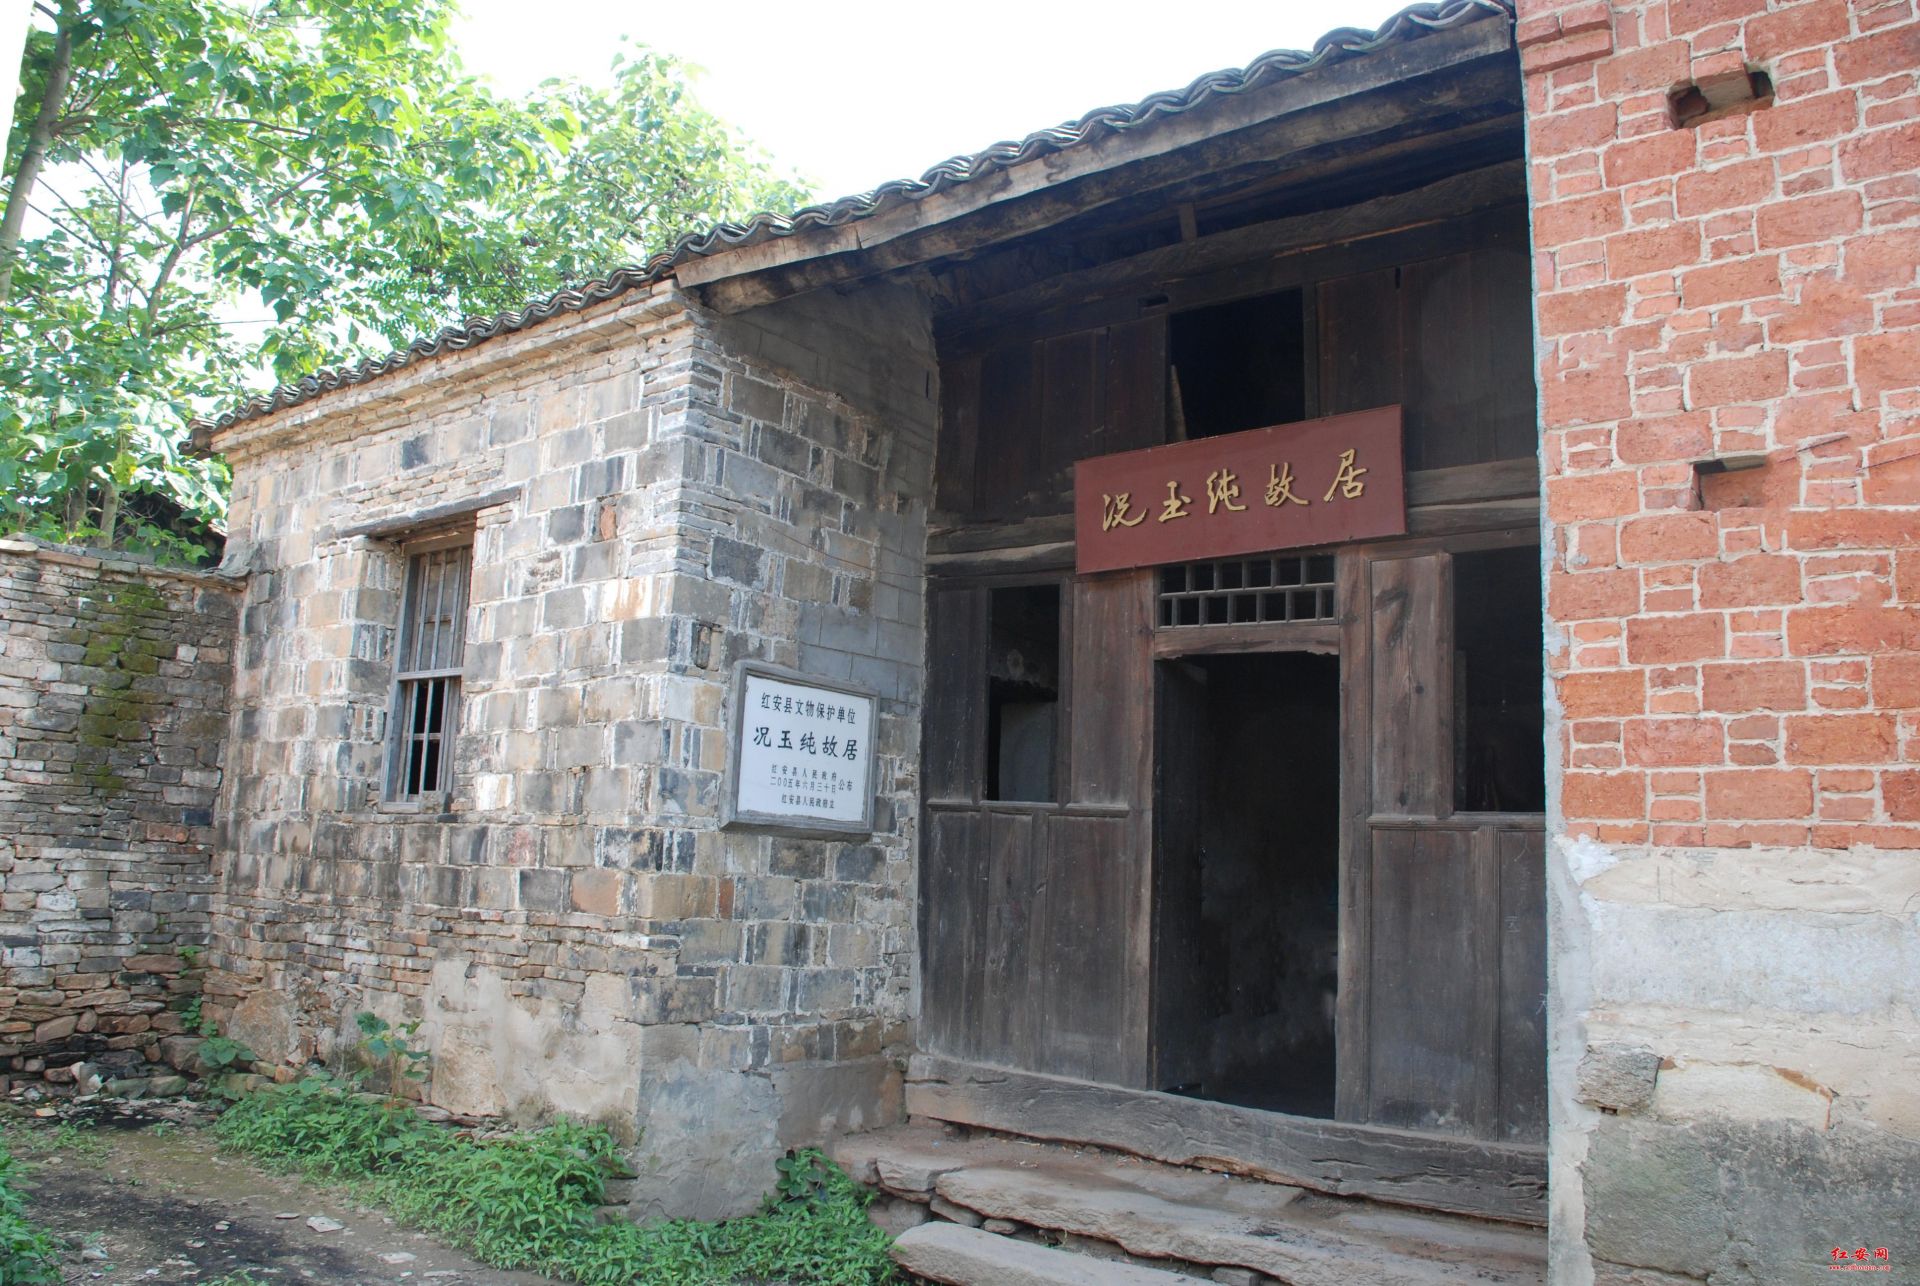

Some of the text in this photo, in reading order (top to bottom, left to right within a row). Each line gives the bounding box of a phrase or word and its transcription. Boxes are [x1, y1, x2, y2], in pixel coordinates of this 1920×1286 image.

[761, 692, 856, 724] 红安县文物保护单位
[753, 726, 858, 761] 况玉纯故居
[771, 764, 837, 781] 红安县人民政府
